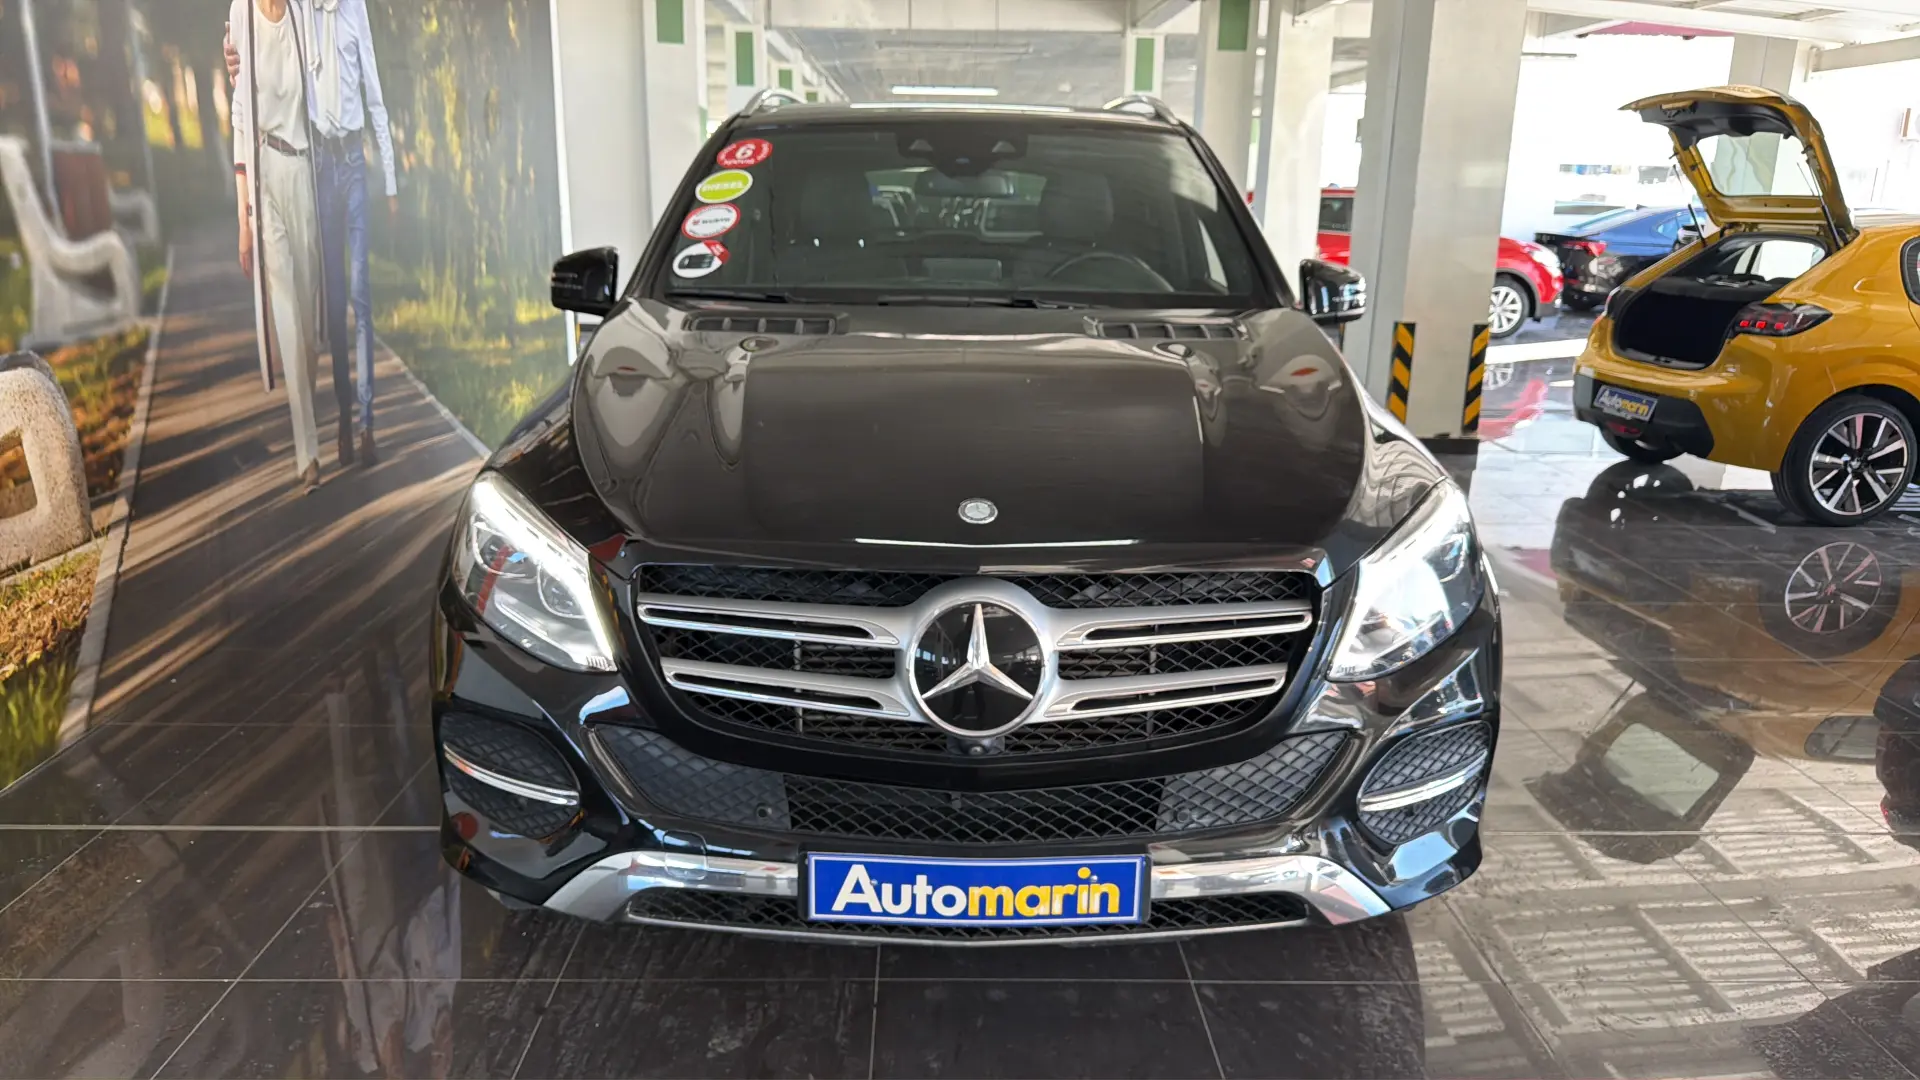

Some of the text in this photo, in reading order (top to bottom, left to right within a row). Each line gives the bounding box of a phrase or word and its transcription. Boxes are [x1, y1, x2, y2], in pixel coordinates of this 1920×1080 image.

[735, 143, 756, 160] 6
[1598, 389, 1649, 416] Automarin
[831, 864, 1120, 917] Automarin
